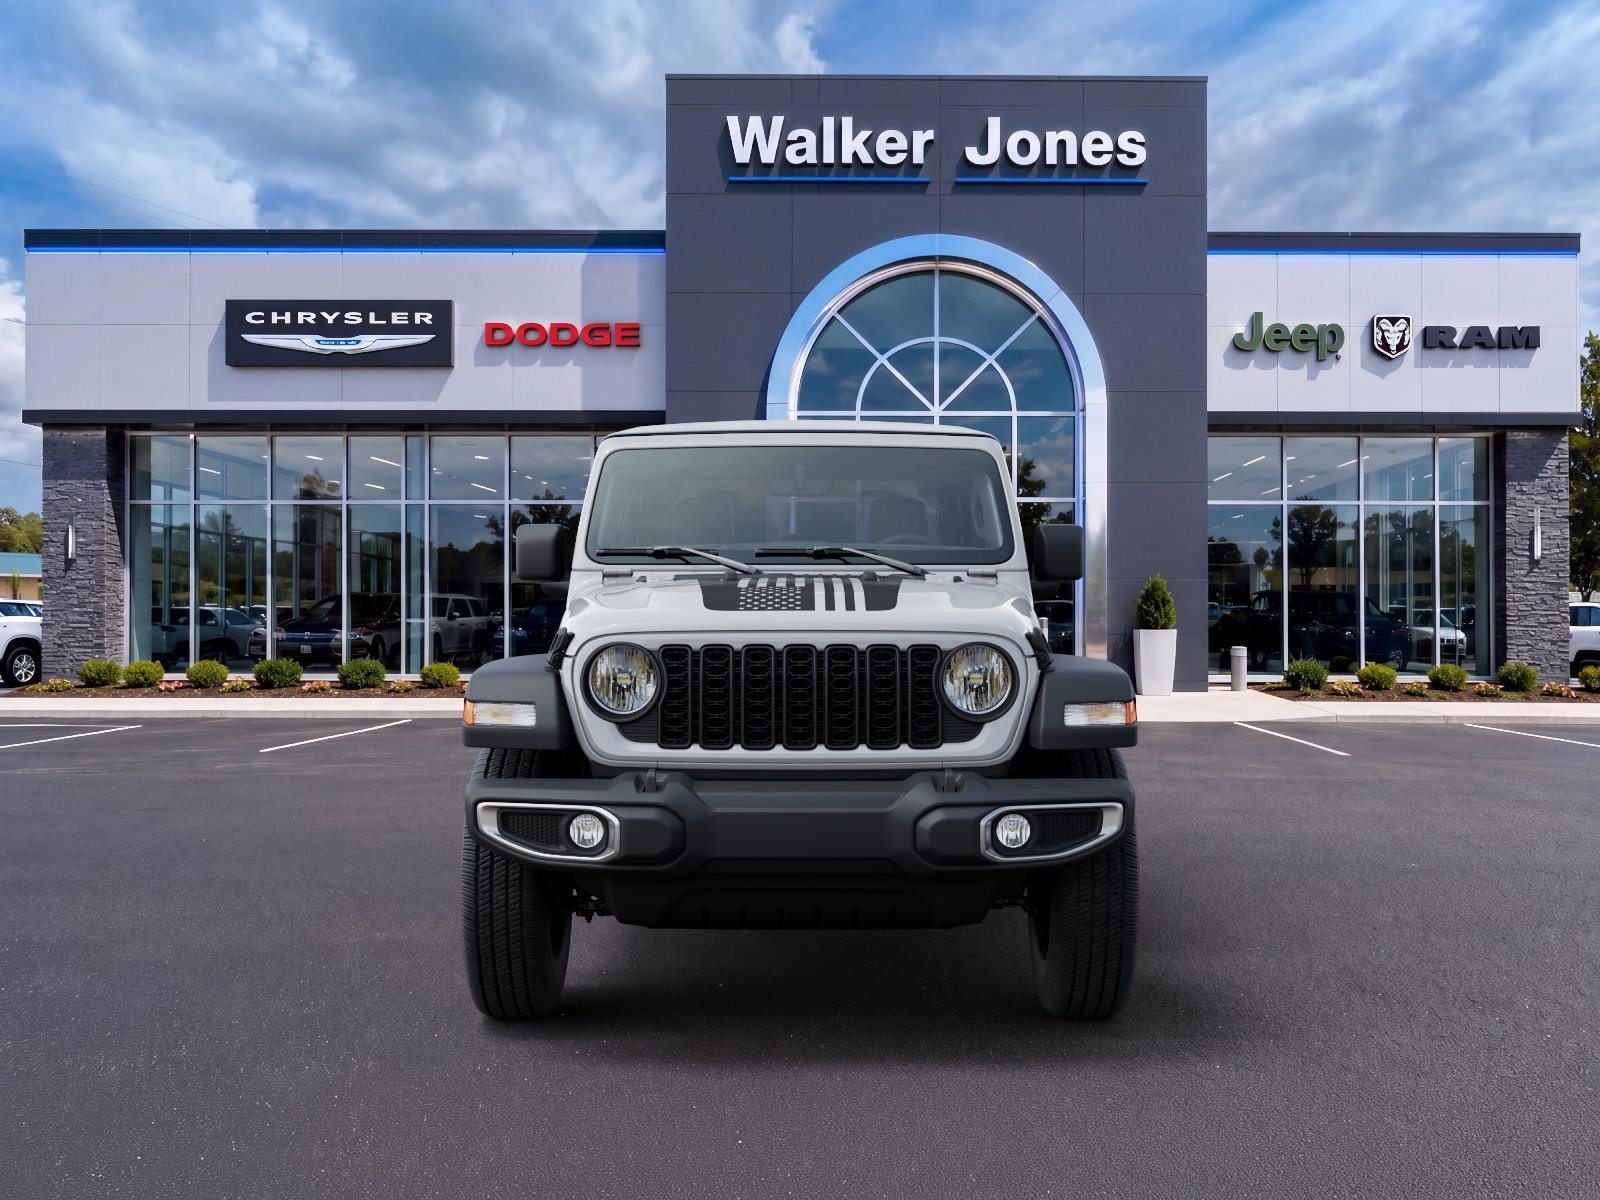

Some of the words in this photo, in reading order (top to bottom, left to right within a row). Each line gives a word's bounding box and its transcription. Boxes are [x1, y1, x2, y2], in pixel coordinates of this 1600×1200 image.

[726, 115, 934, 165] Walker
[964, 116, 1147, 166] Jones
[245, 311, 433, 325] CHRYSLER
[485, 322, 641, 348] DODGE
[1233, 311, 1345, 361] Jeep
[1424, 325, 1541, 348] RAM
